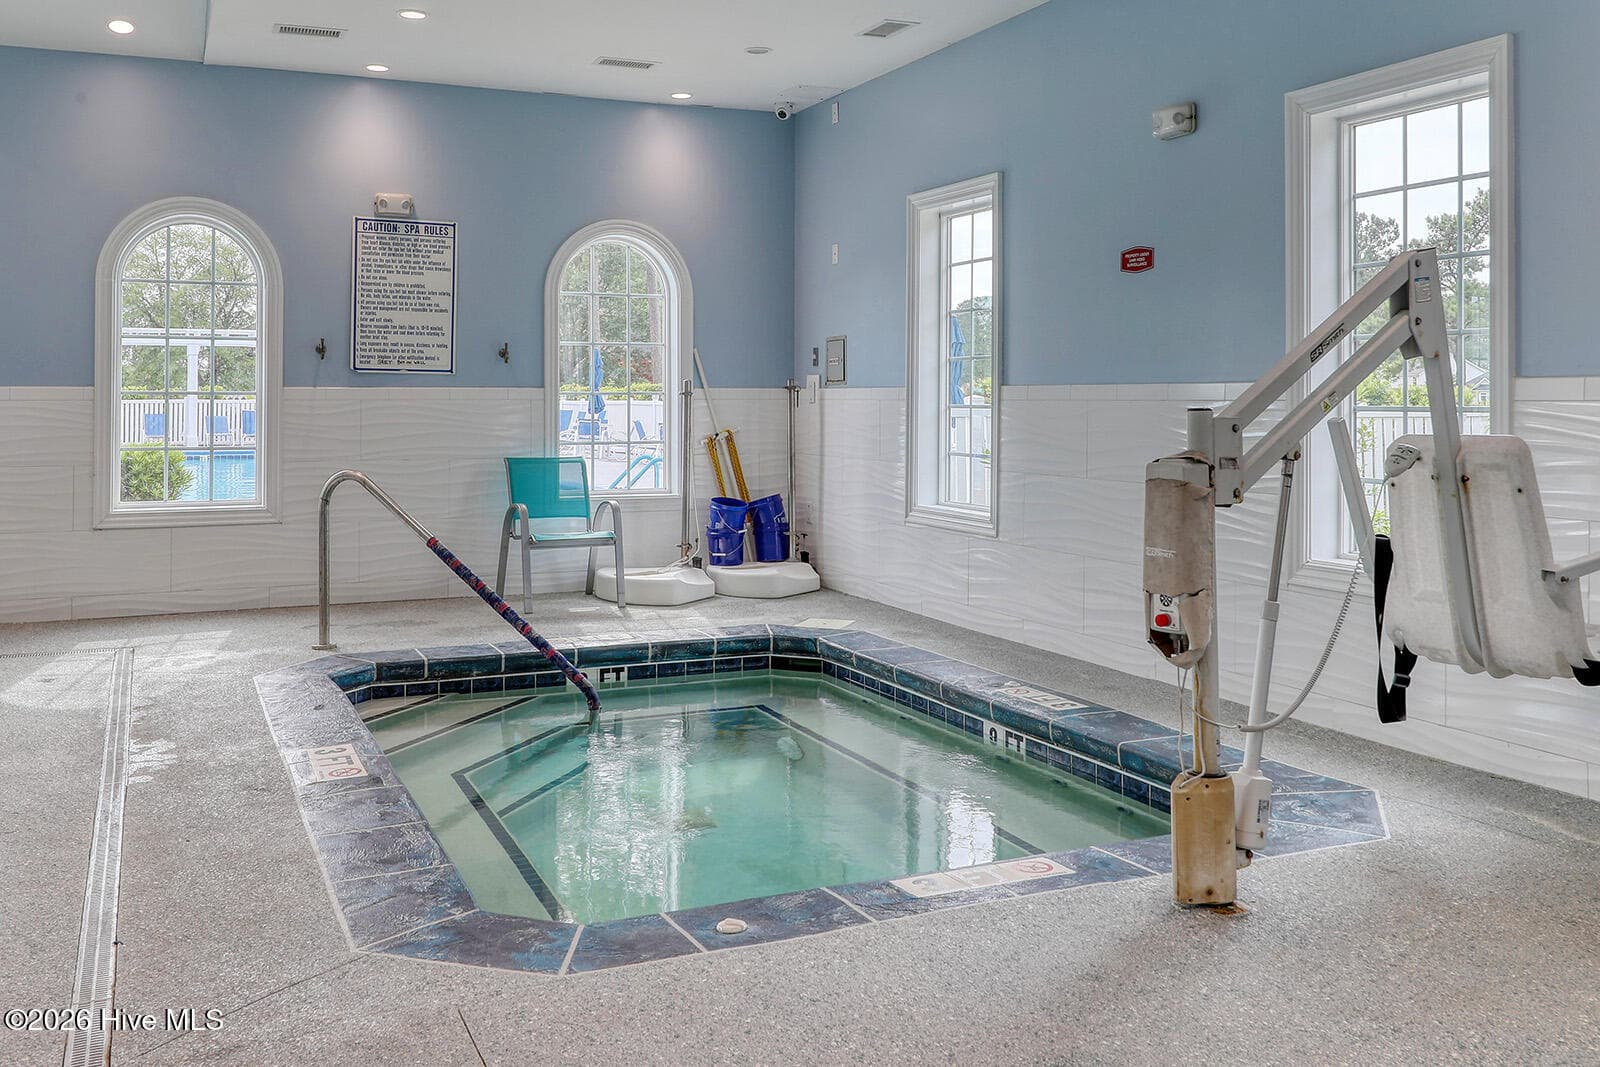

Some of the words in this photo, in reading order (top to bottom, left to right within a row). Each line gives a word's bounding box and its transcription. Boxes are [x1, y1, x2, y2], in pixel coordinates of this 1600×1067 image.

[363, 222, 400, 232] CAUTION:
[405, 224, 420, 234] SPA
[424, 225, 449, 235] RULES
[600, 667, 625, 682] FT
[1005, 730, 1024, 752] FT
